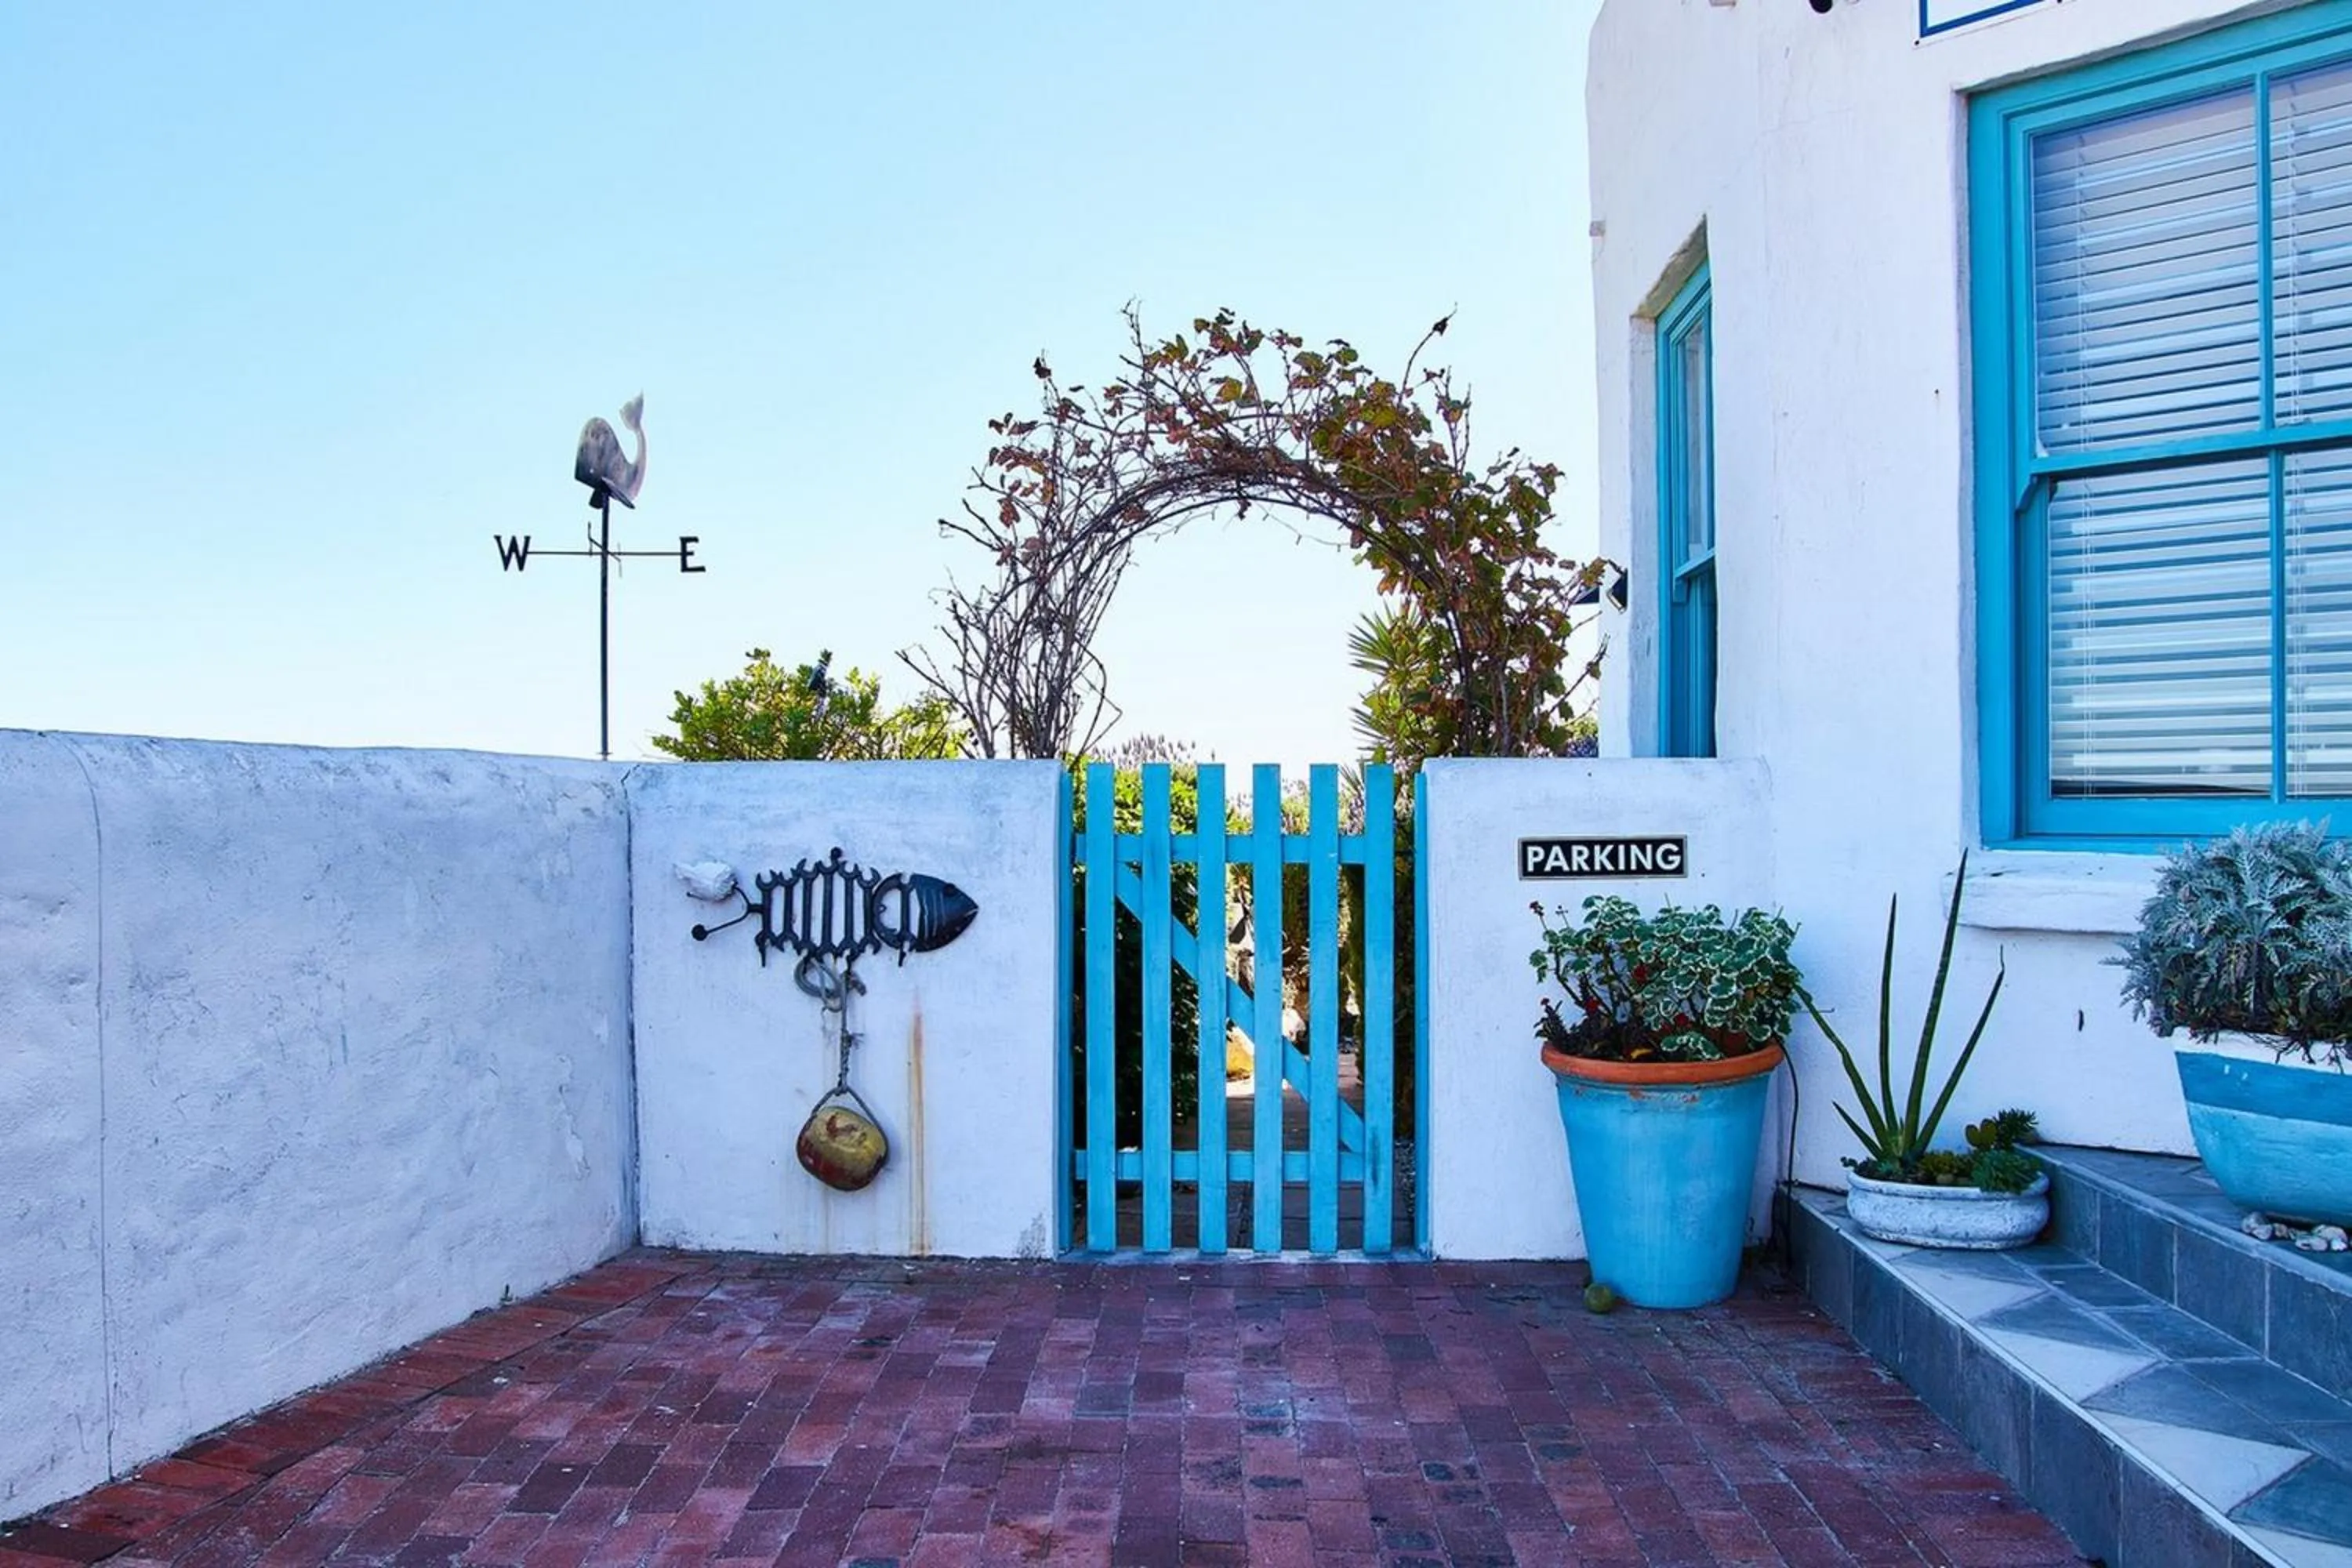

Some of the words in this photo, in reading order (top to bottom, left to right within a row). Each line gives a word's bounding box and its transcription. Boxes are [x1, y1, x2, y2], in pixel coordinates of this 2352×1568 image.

[494, 535, 531, 572] W
[679, 536, 706, 572] E
[1526, 843, 1682, 872] PARKING
